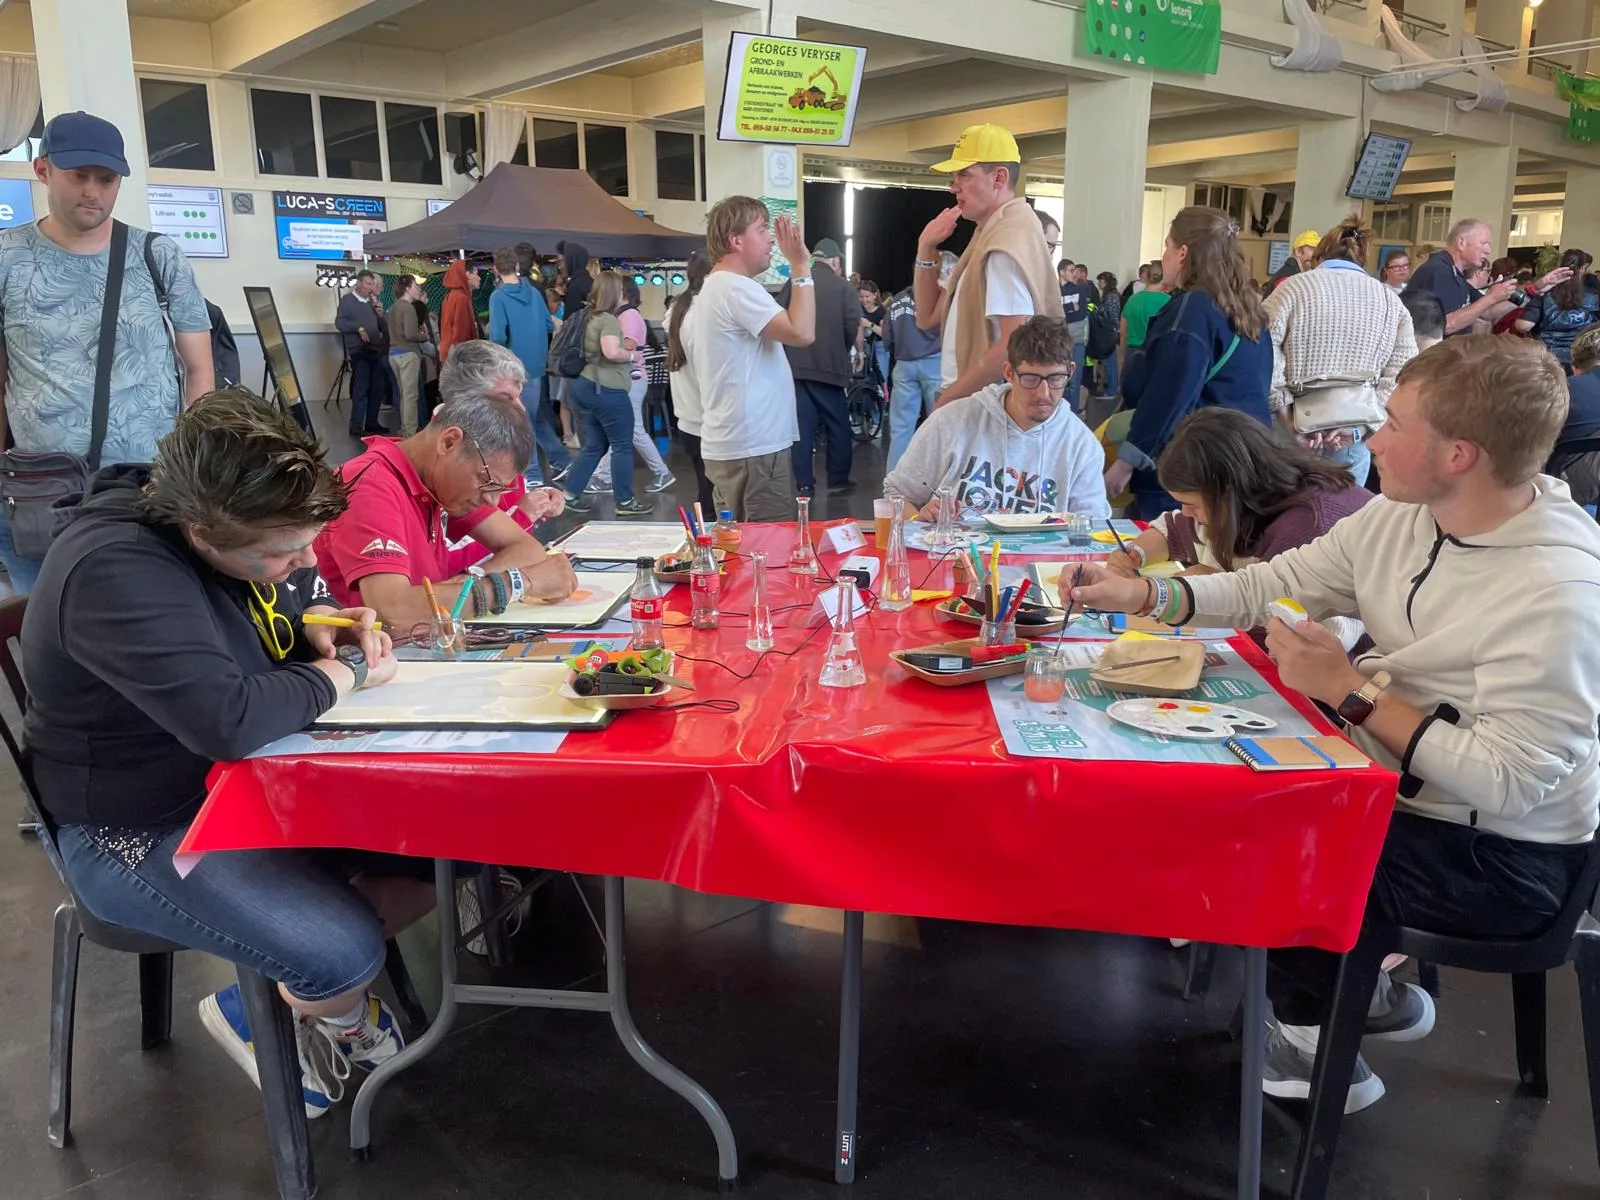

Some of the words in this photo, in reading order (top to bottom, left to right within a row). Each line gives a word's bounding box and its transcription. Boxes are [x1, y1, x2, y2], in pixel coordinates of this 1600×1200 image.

[752, 42, 798, 57] GEORGES
[801, 47, 841, 62] VERYSER
[750, 57, 776, 67] GROND-
[776, 59, 785, 67] EN
[748, 67, 804, 79] AFBRAAKWERKEN
[960, 456, 1040, 500] JACK
[1041, 478, 1059, 506] &
